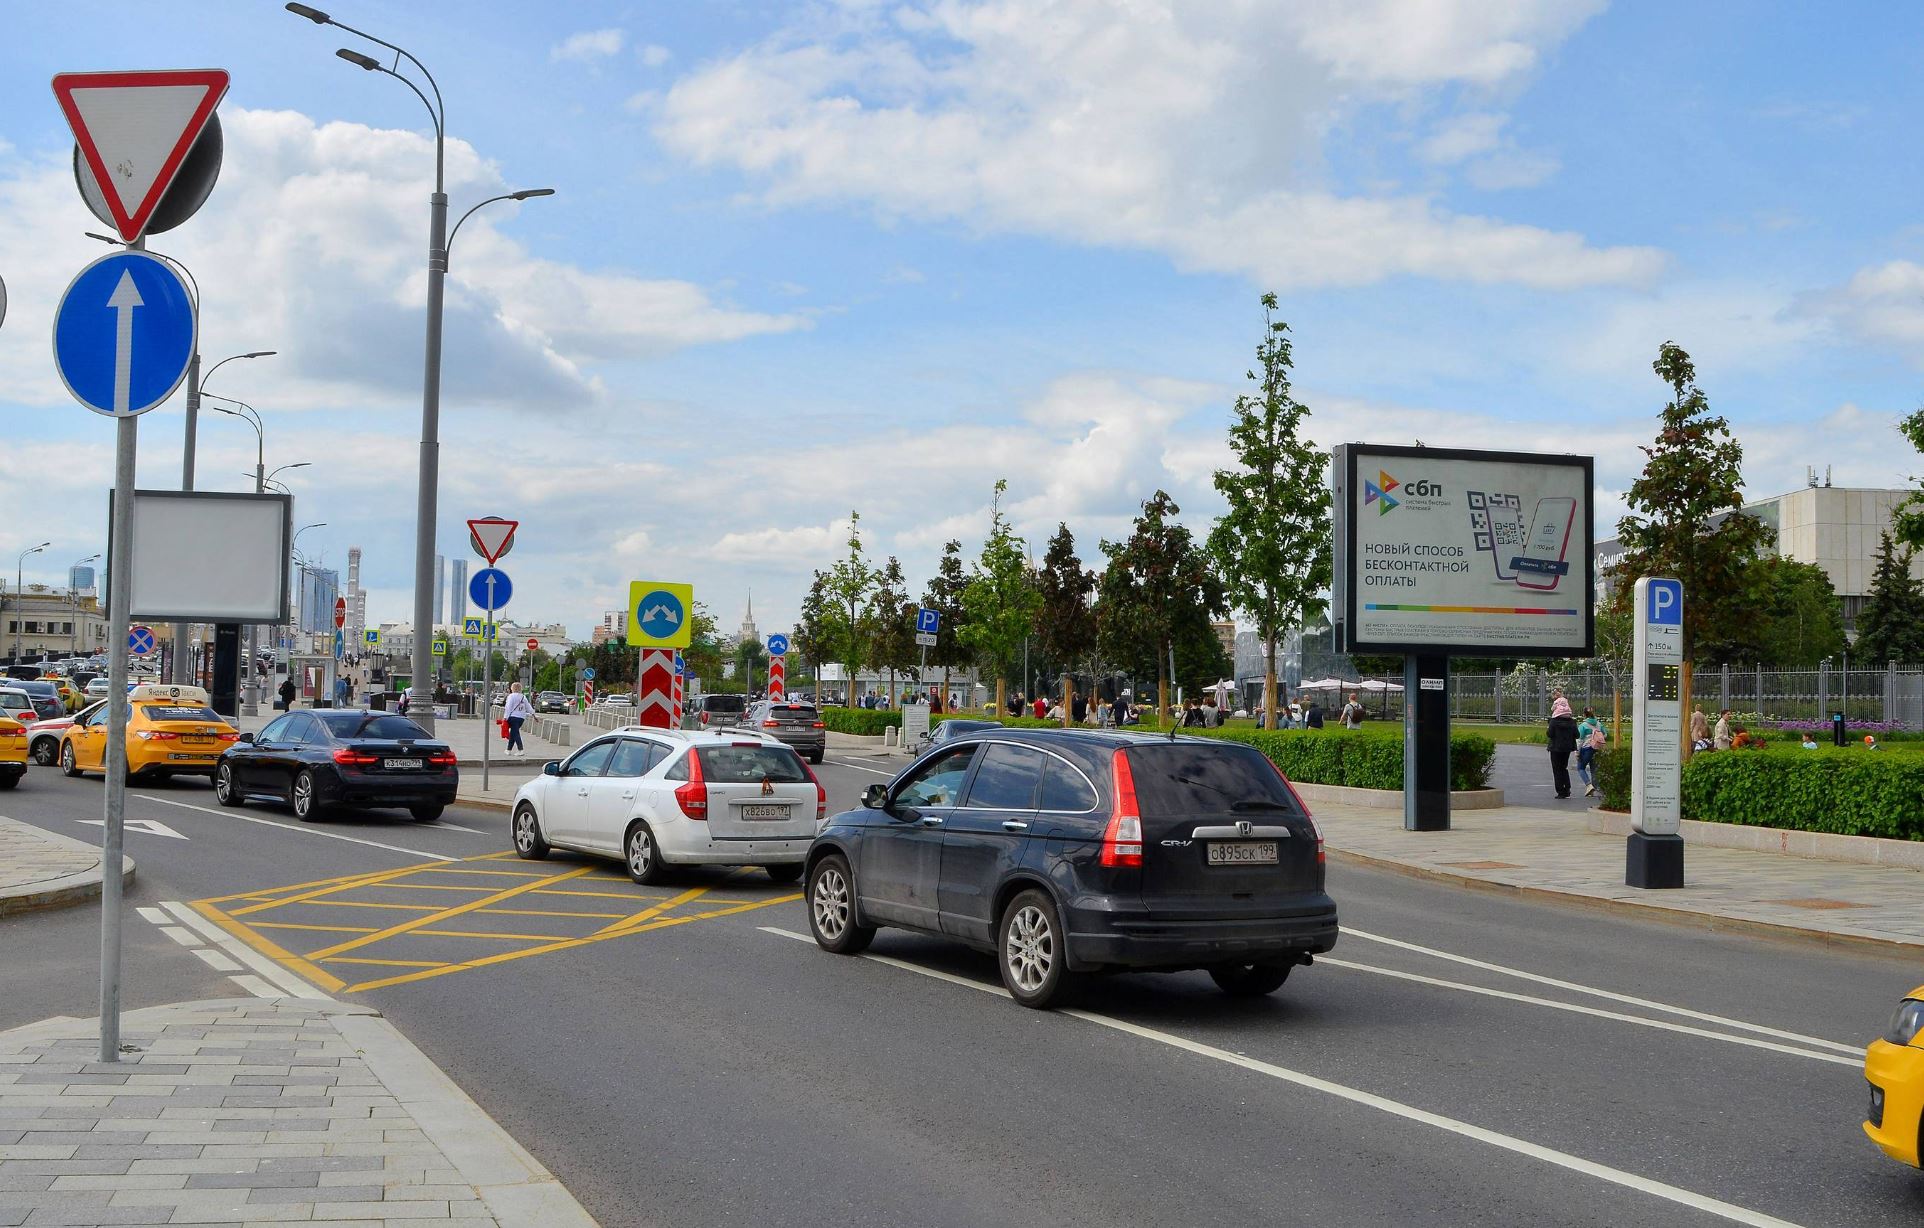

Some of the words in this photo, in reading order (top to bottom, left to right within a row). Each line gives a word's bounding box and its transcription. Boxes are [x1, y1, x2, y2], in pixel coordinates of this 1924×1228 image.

[1404, 479, 1442, 497] сбп
[1365, 542, 1410, 555] НОВЫЙ
[1414, 545, 1464, 557] СПОСОБ
[1365, 559, 1469, 573] БЕСКОНТАКТНОЙ
[1365, 575, 1417, 587] ОПЛАТЫ
[1654, 586, 1674, 619] P
[922, 611, 935, 629] P
[1654, 642, 1667, 650] 150
[148, 688, 169, 697] Яндекс
[1211, 845, 1256, 860] О895СК
[1258, 844, 1274, 855] 199
